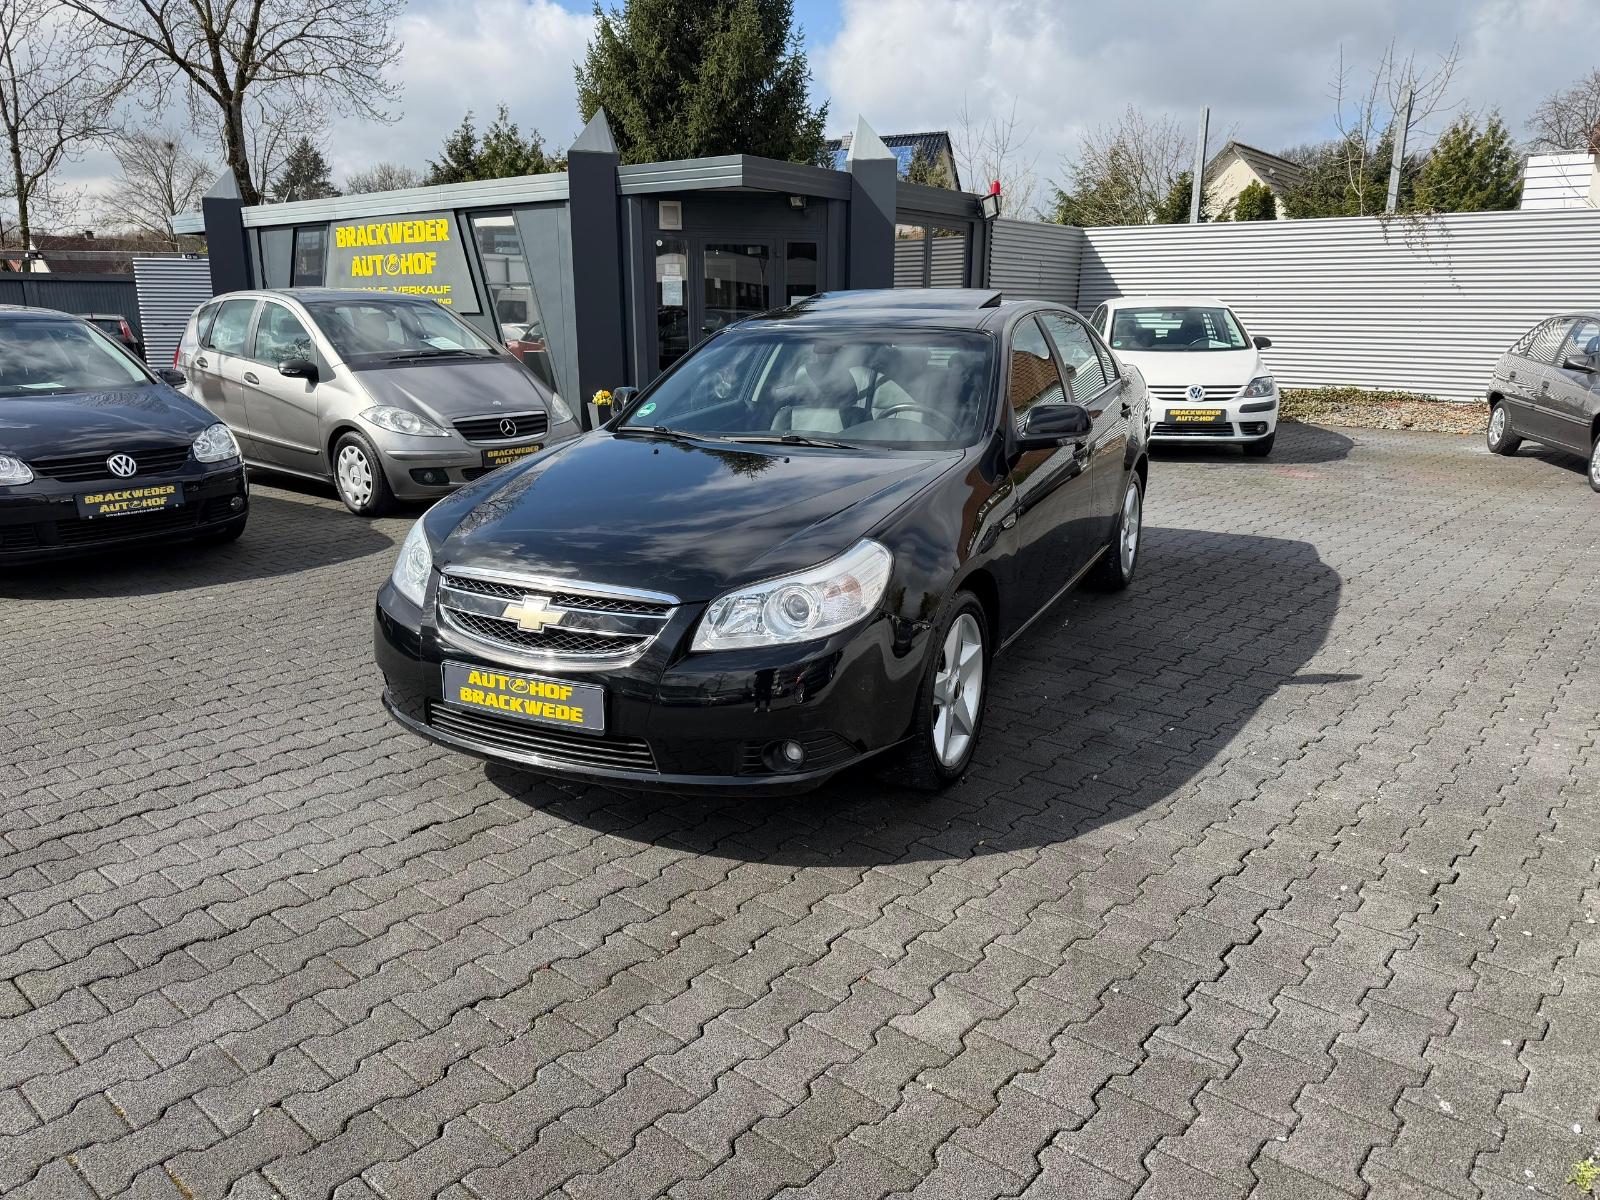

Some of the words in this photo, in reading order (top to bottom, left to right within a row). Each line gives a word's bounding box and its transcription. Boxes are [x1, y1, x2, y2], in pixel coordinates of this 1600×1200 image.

[336, 218, 449, 248] BRACKWEDER
[392, 285, 452, 295] VERKAUF
[488, 445, 539, 458] BRACKWEDER
[84, 485, 176, 505] BRACKWEDER
[459, 687, 584, 723] BRACKWEDE
